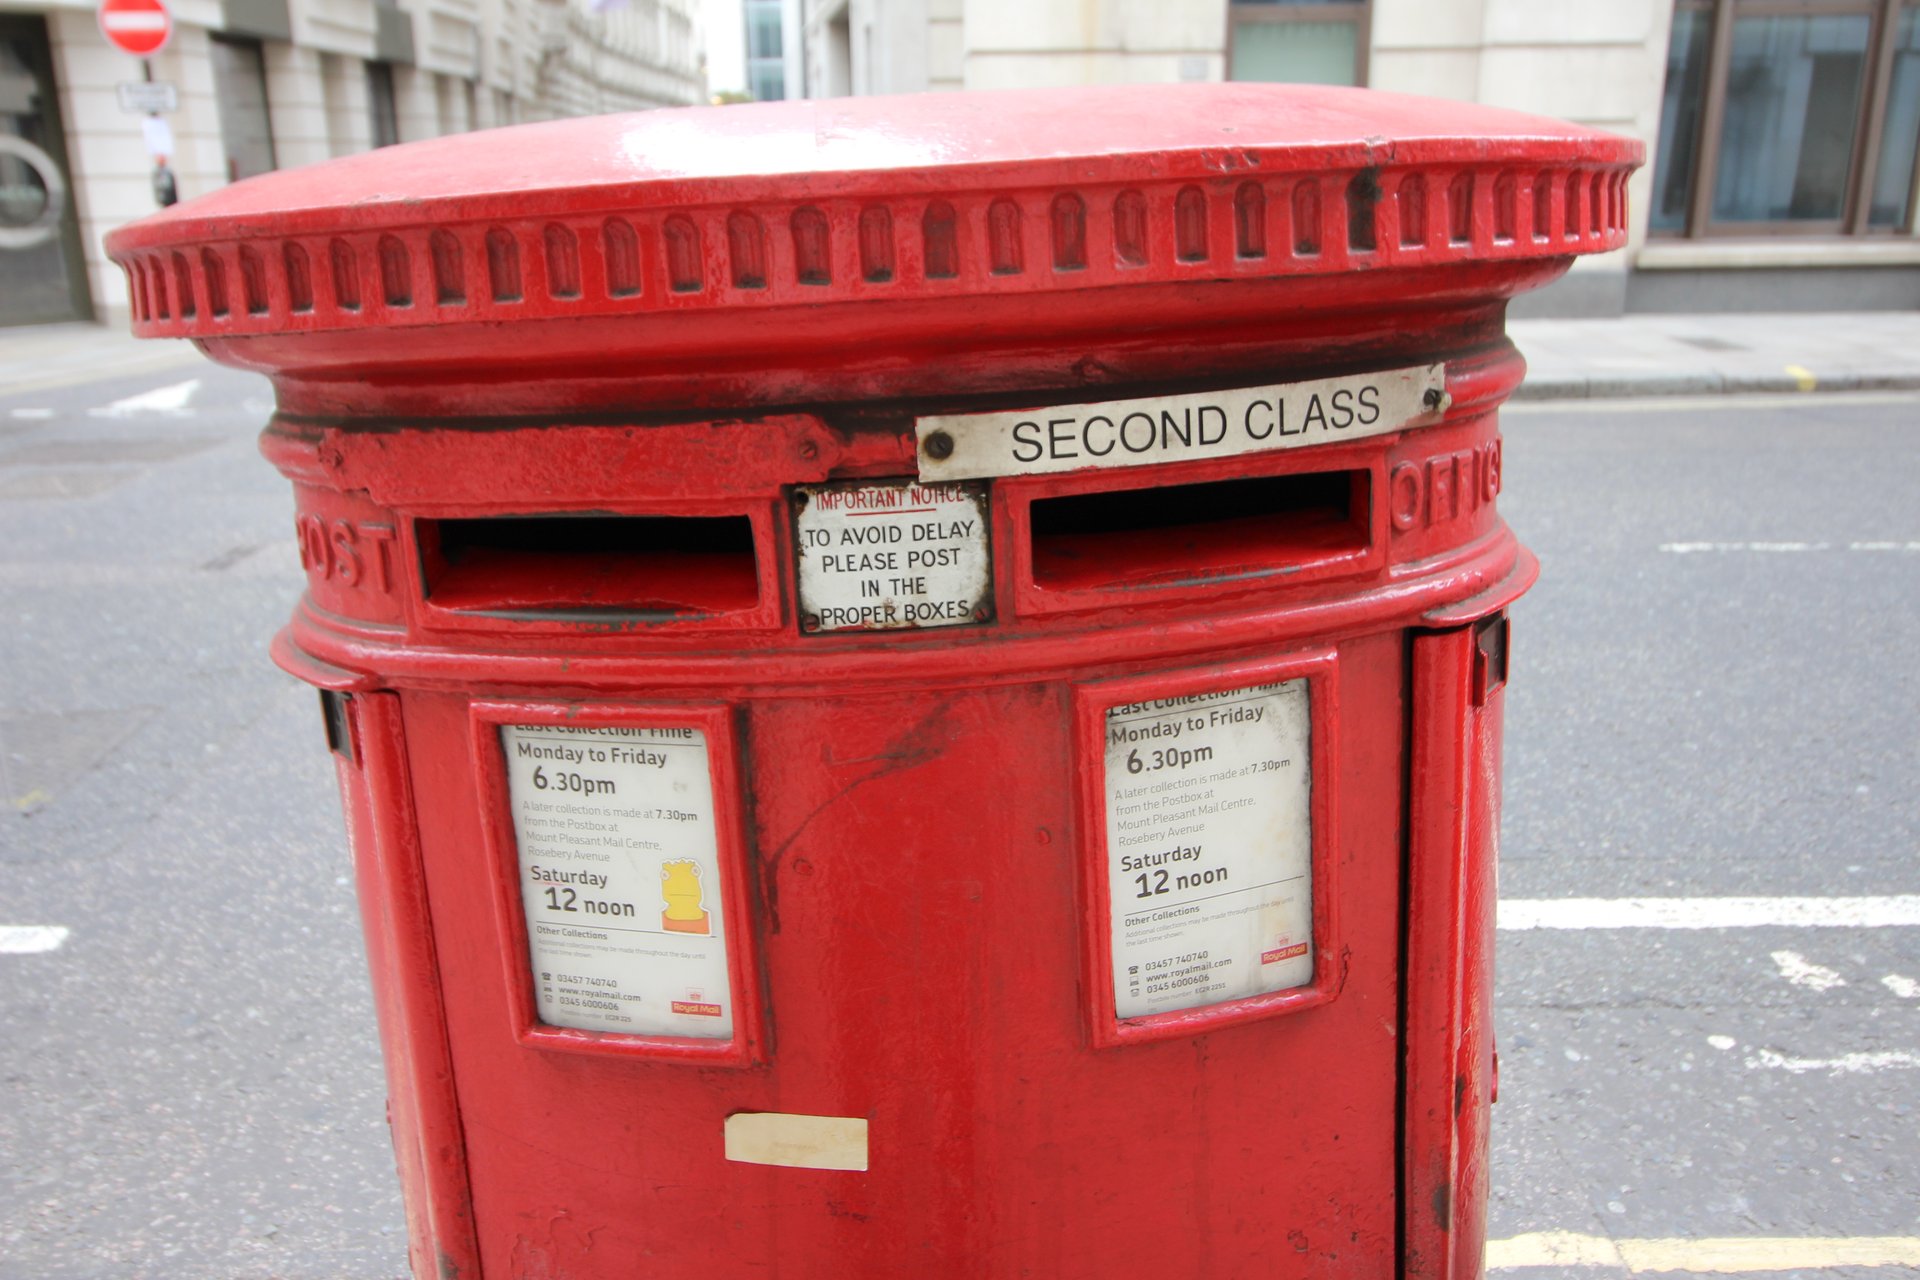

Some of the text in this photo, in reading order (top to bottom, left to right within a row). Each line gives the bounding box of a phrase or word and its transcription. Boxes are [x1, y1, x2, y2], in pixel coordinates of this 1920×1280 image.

[1011, 385, 1381, 463] SECOND CLASS
[1391, 433, 1503, 531] OFFIC
[816, 485, 964, 511] IMPORTANT NOTICE
[805, 520, 975, 547] TO AVOID DELAY
[822, 548, 961, 573] PLEASE POST
[861, 577, 927, 598] IN THE
[821, 600, 970, 625] PROPER BOXES
[1111, 706, 1264, 745] Monday to Friday
[517, 742, 667, 768] Monday to Friday
[1127, 745, 1213, 774] 6.30pm
[533, 766, 616, 796] 6.30pm
[1115, 759, 1291, 800] A later collection is made at 7.30pm
[522, 801, 698, 822] A later collection is made at 7.30pm
[1116, 790, 1214, 816] from the Postbox at
[524, 817, 619, 832] from the Postbox at
[1117, 819, 1151, 832] Mount
[1153, 809, 1196, 825] Pleasant
[1198, 802, 1219, 814] Mail
[526, 831, 558, 843] Mount
[559, 833, 601, 846] Pleasant
[603, 835, 624, 847] Mail
[1118, 823, 1205, 847] Rosebery Avenue
[527, 846, 611, 862] Rosebery Avenue
[1121, 845, 1202, 872] Saturday
[531, 865, 608, 889] Saturday
[1135, 866, 1228, 898] 12 noon
[544, 887, 635, 917] 12 noon
[1125, 905, 1200, 927] Other Collections
[536, 925, 608, 940] Other Collections
[1145, 950, 1208, 971] 03457 740740
[1264, 944, 1306, 961] Royal Mail
[557, 974, 617, 988] 03457 740740
[1146, 958, 1232, 983] www.royalmail.com
[558, 986, 641, 1002] www.royalmail.com
[1146, 973, 1210, 994] 0345 6000606
[559, 996, 619, 1011] 0345 6000606
[673, 1002, 720, 1014] Royal Mail
